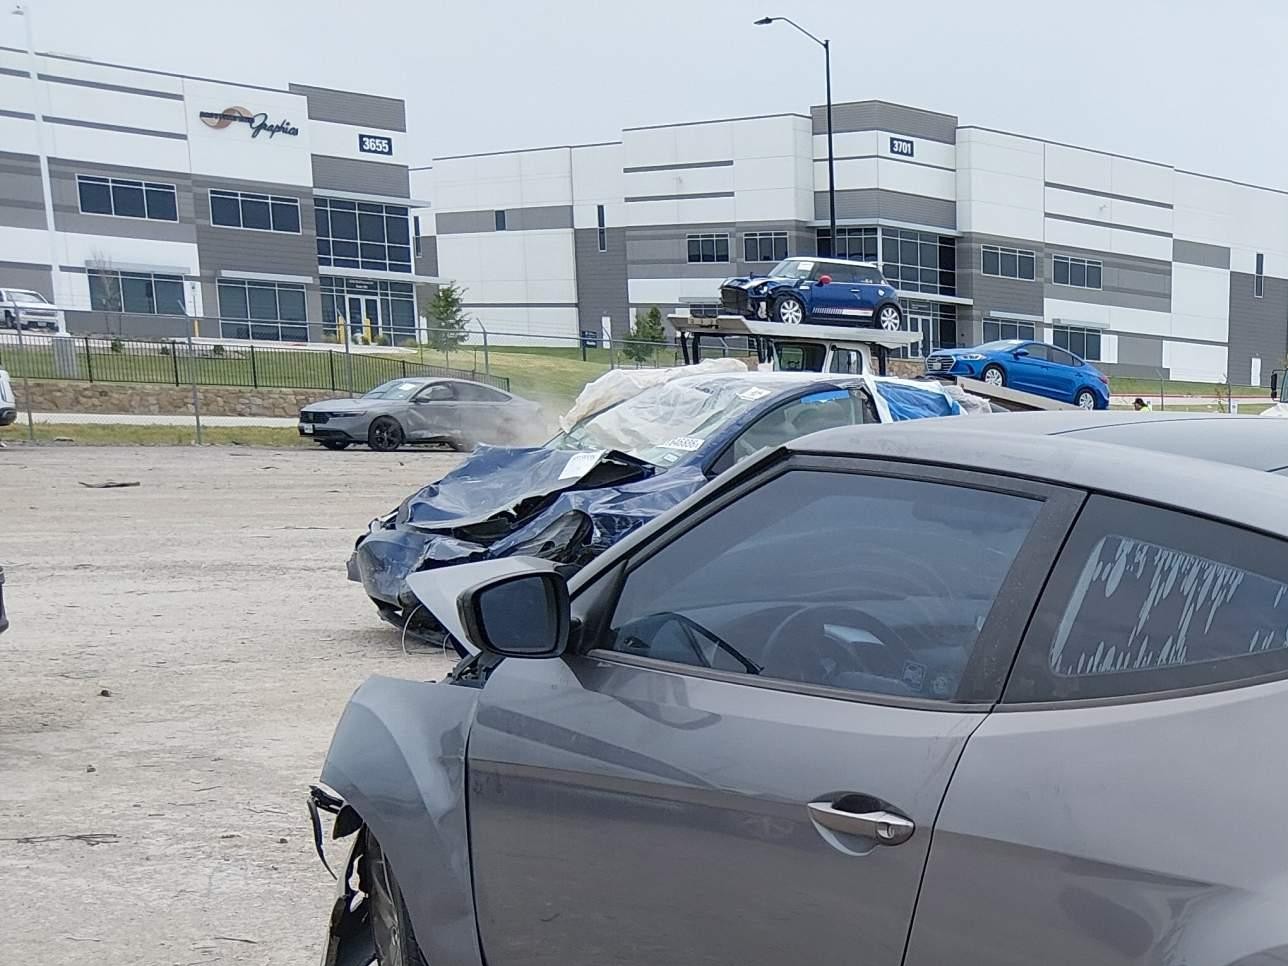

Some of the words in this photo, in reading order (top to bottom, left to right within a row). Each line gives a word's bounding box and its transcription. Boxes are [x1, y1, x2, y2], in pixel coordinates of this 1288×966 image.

[249, 112, 299, 138] Graphics
[362, 137, 389, 152] 3655
[892, 140, 912, 155] 3701
